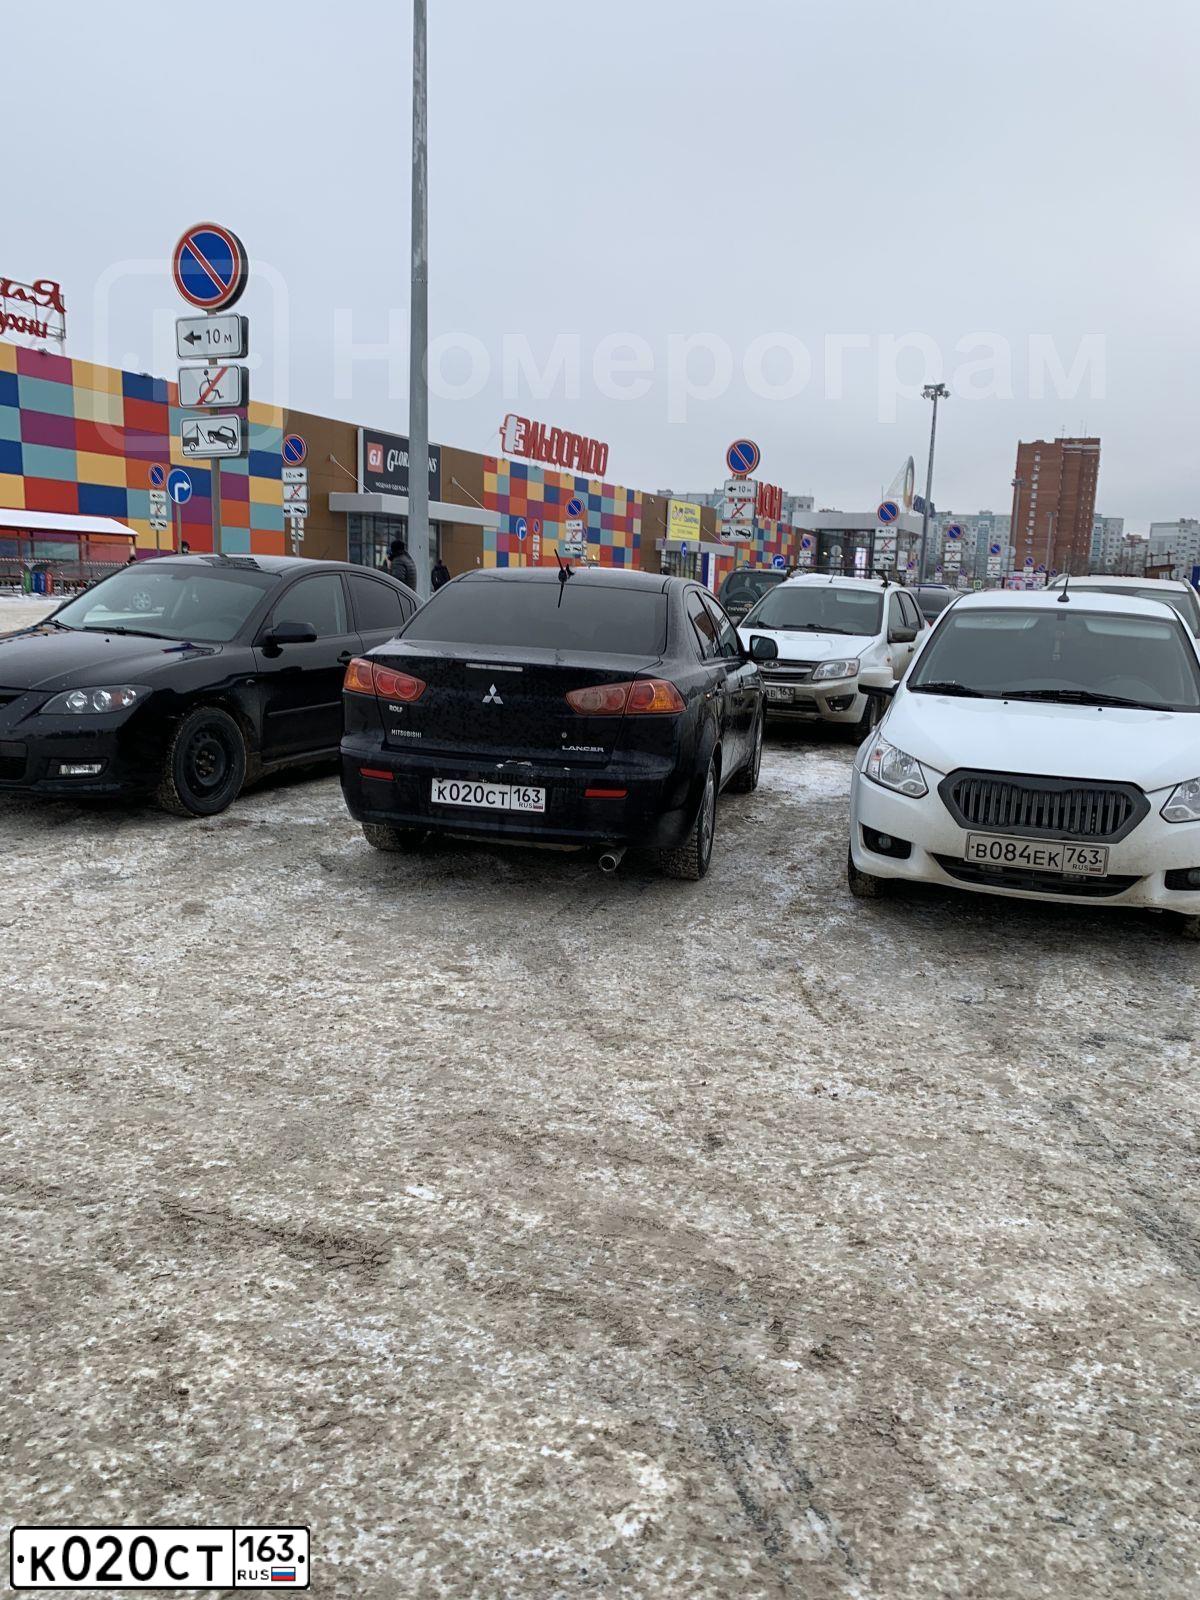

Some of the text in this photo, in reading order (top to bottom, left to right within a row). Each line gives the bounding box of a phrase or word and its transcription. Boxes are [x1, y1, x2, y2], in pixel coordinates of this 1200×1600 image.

[0, 278, 66, 313] ия
[206, 328, 220, 344] 10
[499, 413, 608, 477] ЭЛЬДОРАДО
[369, 449, 381, 466] GJ
[386, 448, 409, 472] GLOR
[738, 485, 746, 493] 10
[391, 728, 422, 738] MITSUBISHI
[561, 745, 604, 753] LANCER
[437, 783, 541, 806] К020СТ 163
[518, 801, 533, 809] RUS
[975, 841, 1061, 868] В084ЕК
[1066, 847, 1099, 865] 763
[1072, 863, 1089, 872] RUS
